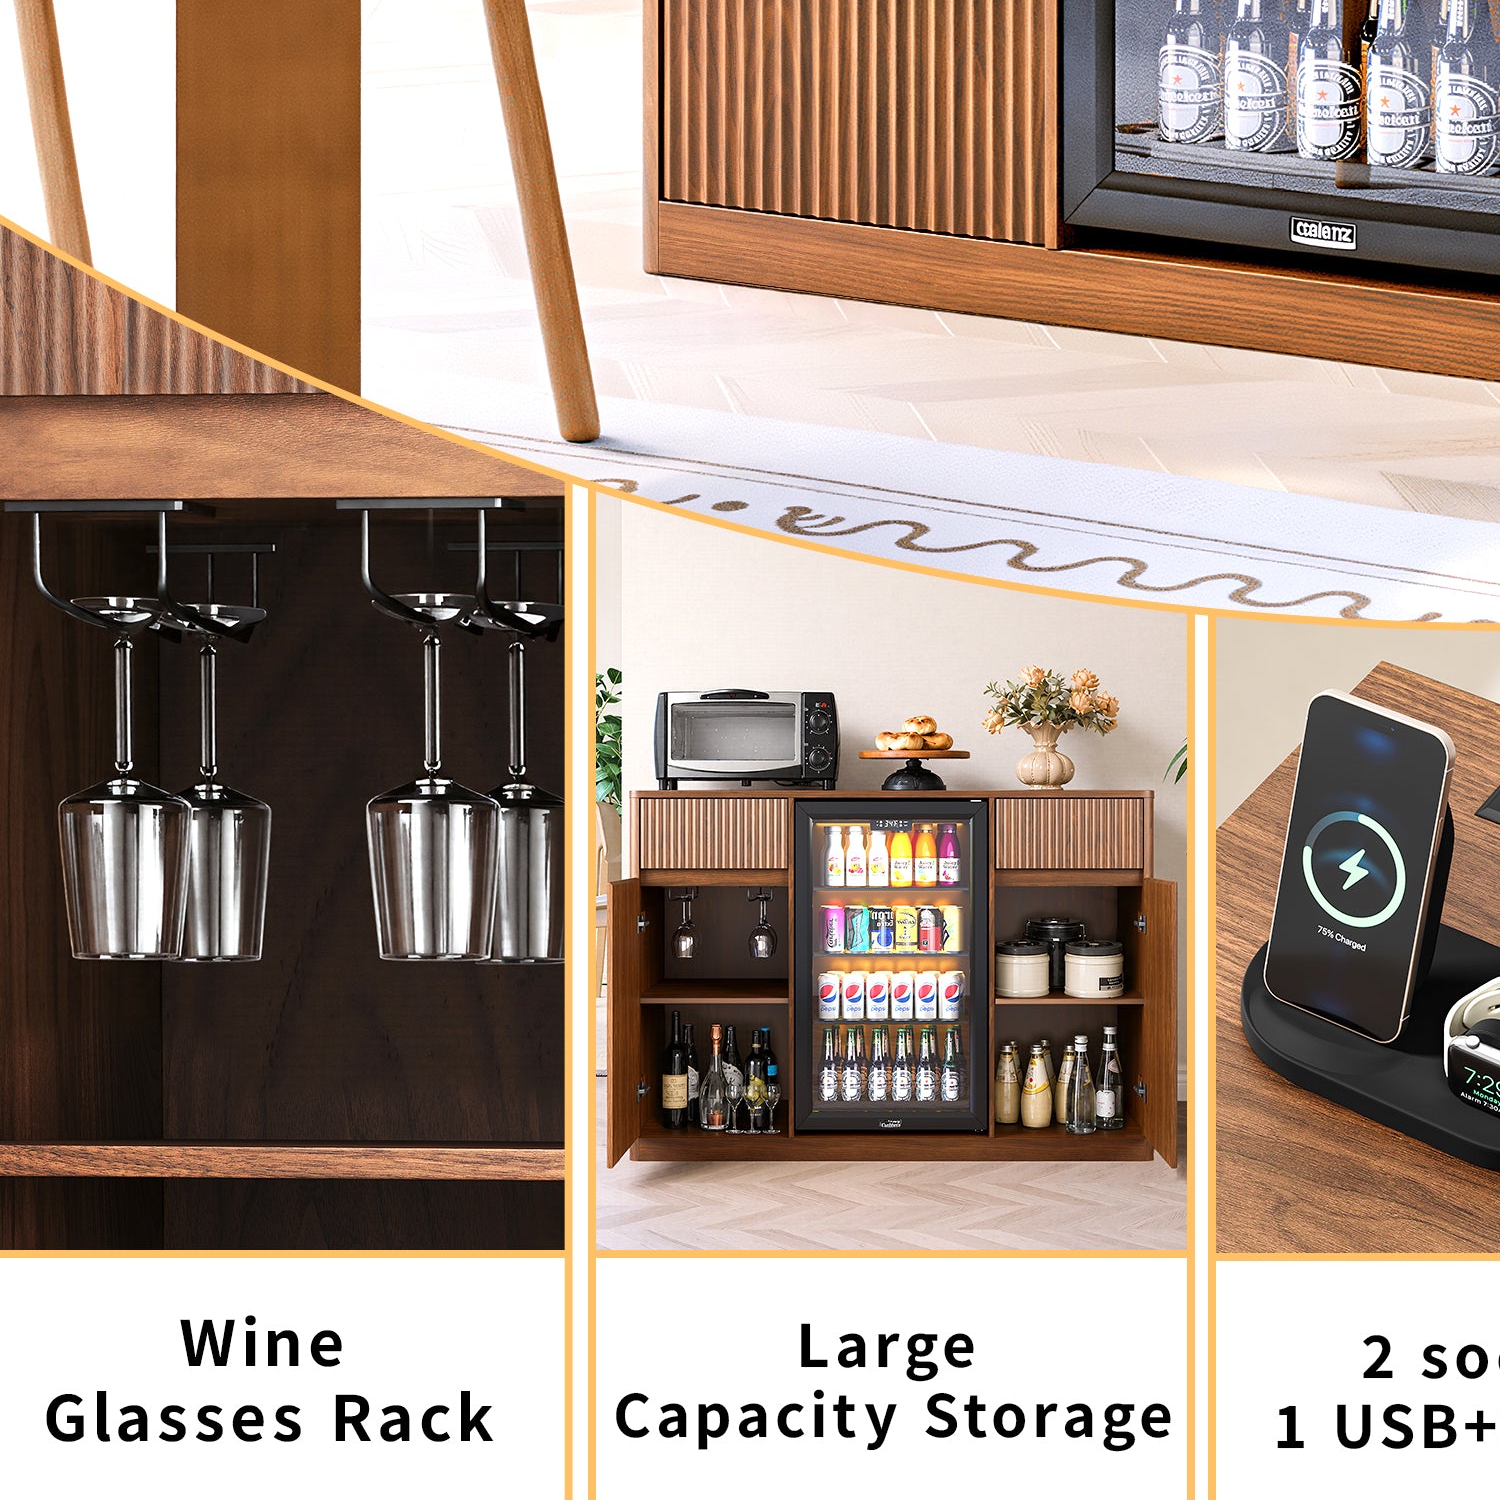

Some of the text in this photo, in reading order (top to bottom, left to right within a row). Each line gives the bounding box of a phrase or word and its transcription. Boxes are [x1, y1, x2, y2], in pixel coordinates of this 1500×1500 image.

[1317, 925, 1367, 952] 75% Charged
[1460, 1092, 1482, 1105] Alarm
